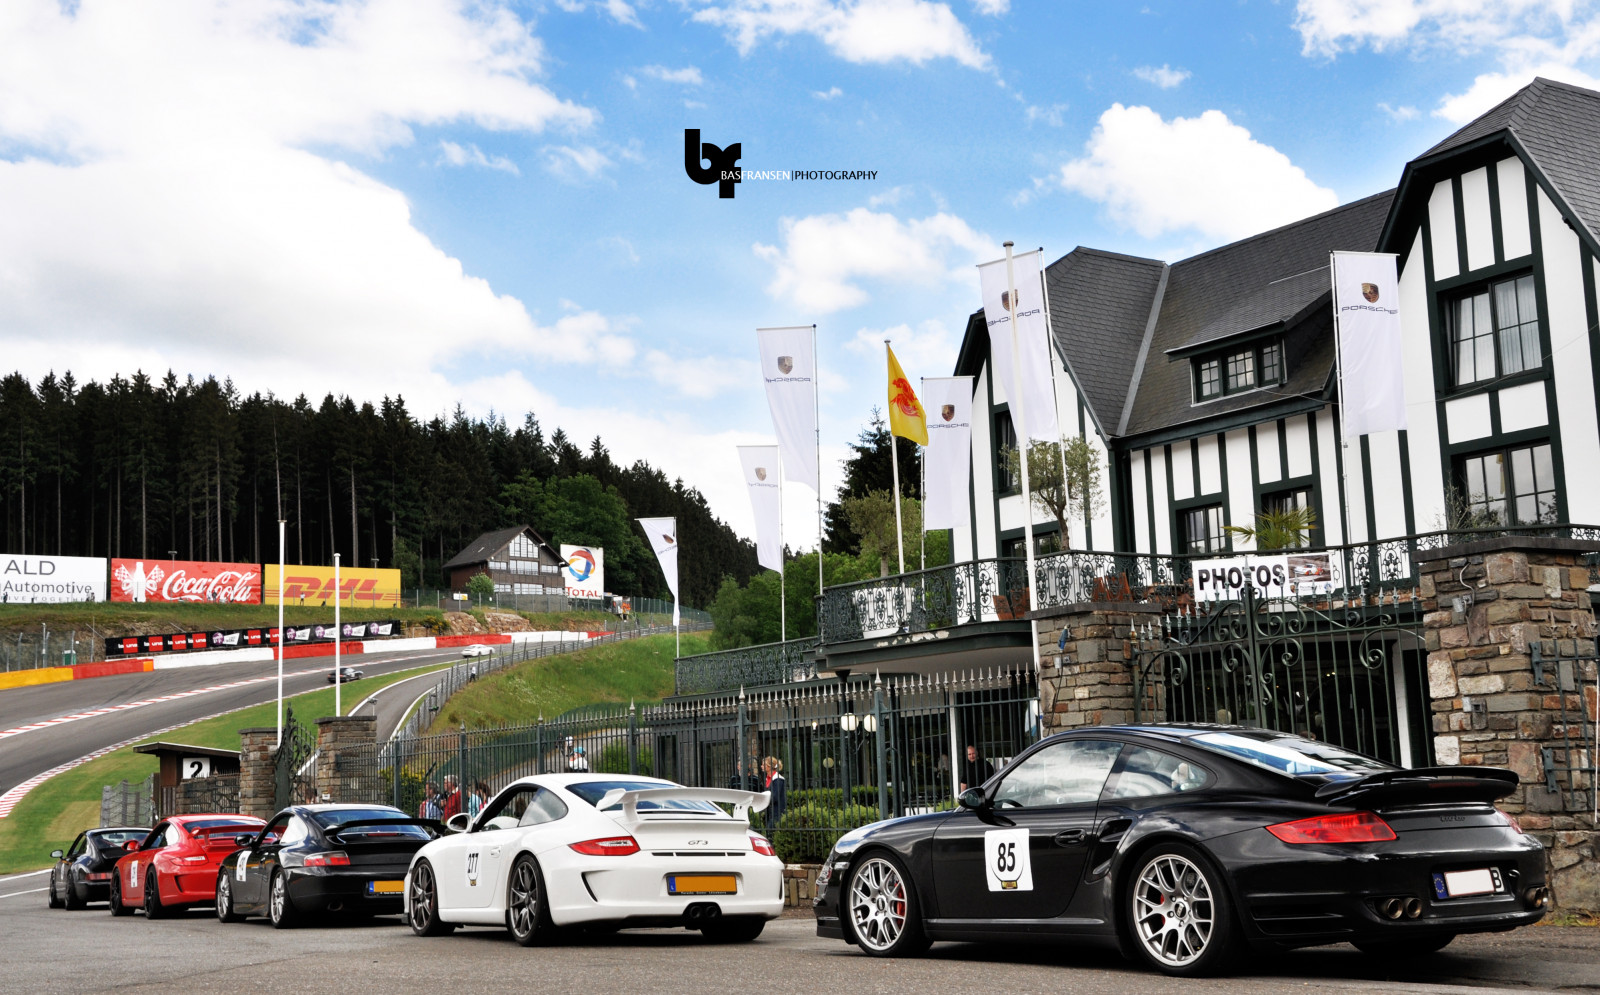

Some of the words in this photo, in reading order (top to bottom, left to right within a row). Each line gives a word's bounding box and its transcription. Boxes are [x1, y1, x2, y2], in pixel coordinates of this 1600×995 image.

[1341, 305, 1398, 314] PORSCHE
[4, 559, 56, 576] ALD
[3, 580, 92, 594] Automotive
[283, 576, 384, 601] DHL
[565, 586, 602, 598] TOTAL
[190, 761, 203, 778] 2
[467, 853, 479, 873] 277
[997, 842, 1016, 873] 85
[1491, 869, 1502, 889] B
